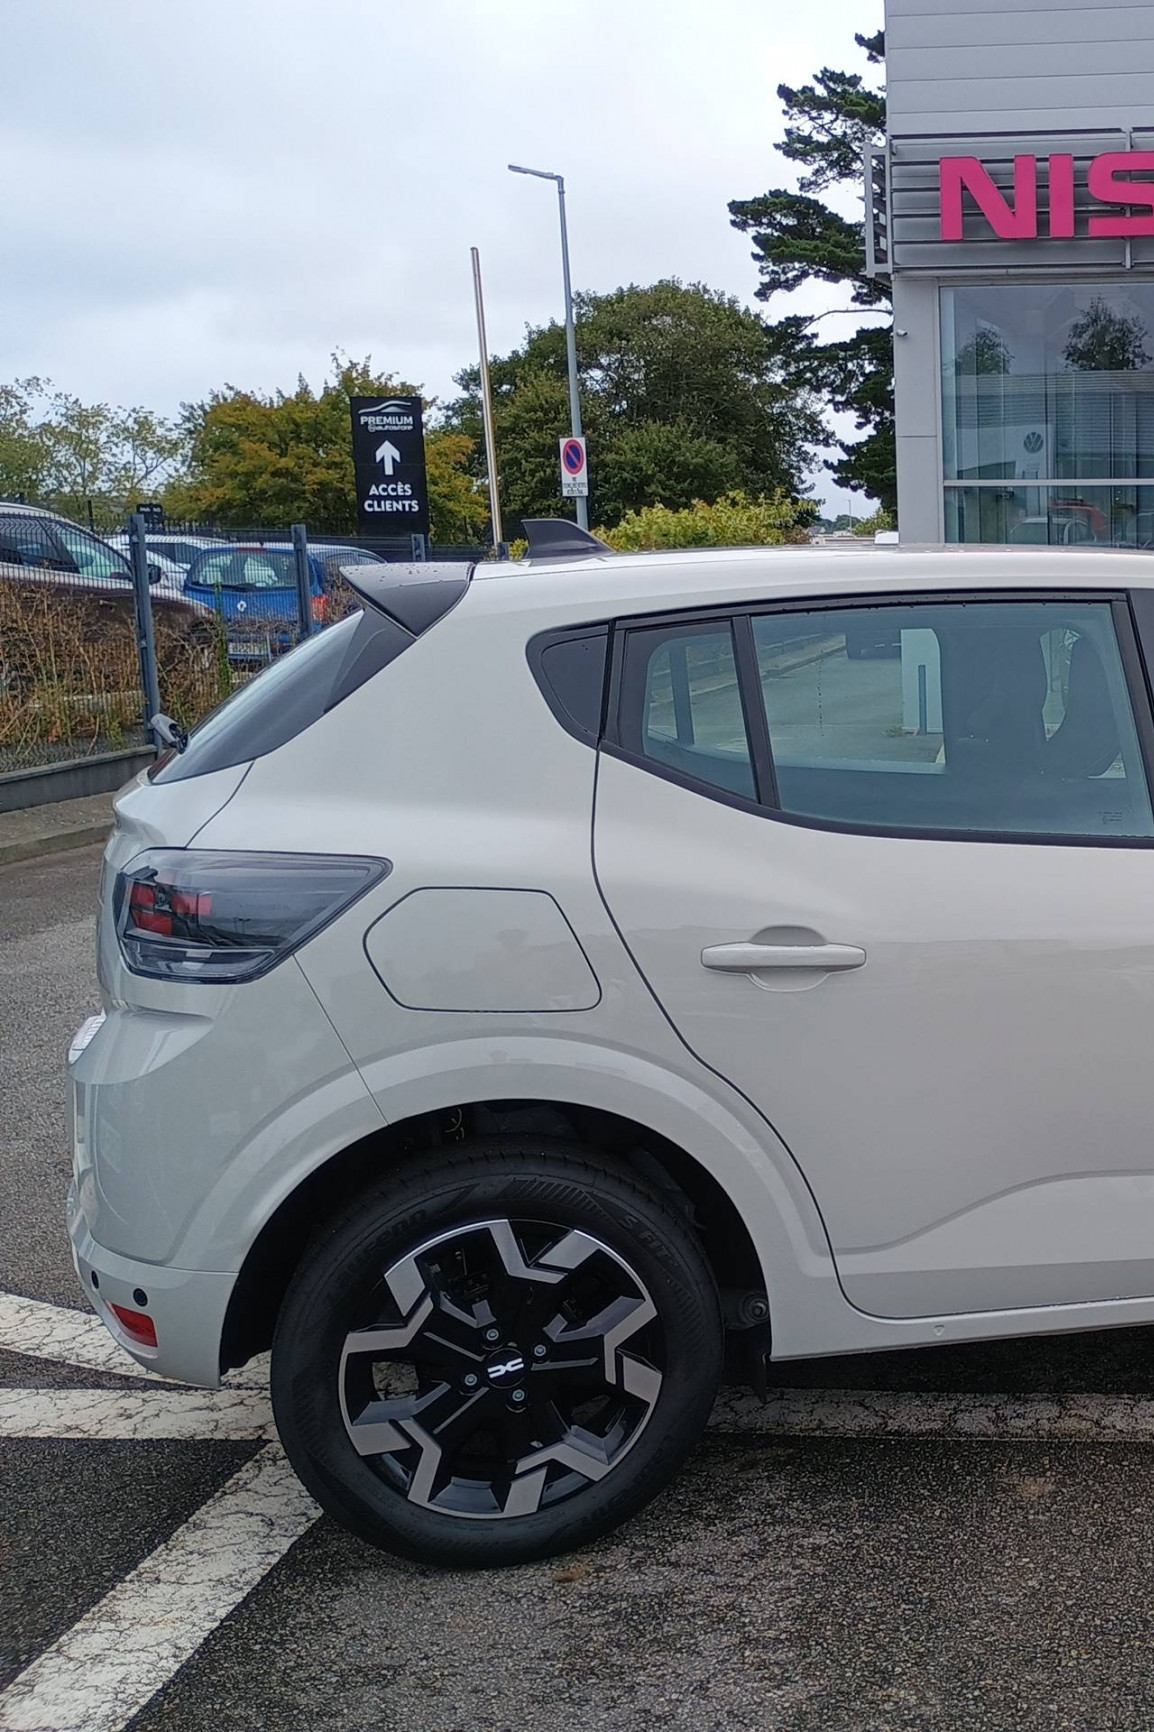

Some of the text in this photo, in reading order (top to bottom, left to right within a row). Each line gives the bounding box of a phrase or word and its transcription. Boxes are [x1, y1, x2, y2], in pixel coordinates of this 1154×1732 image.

[360, 416, 413, 425] PREMIUM
[369, 481, 412, 496] ACCÈS
[364, 500, 419, 512] CLIENTS
